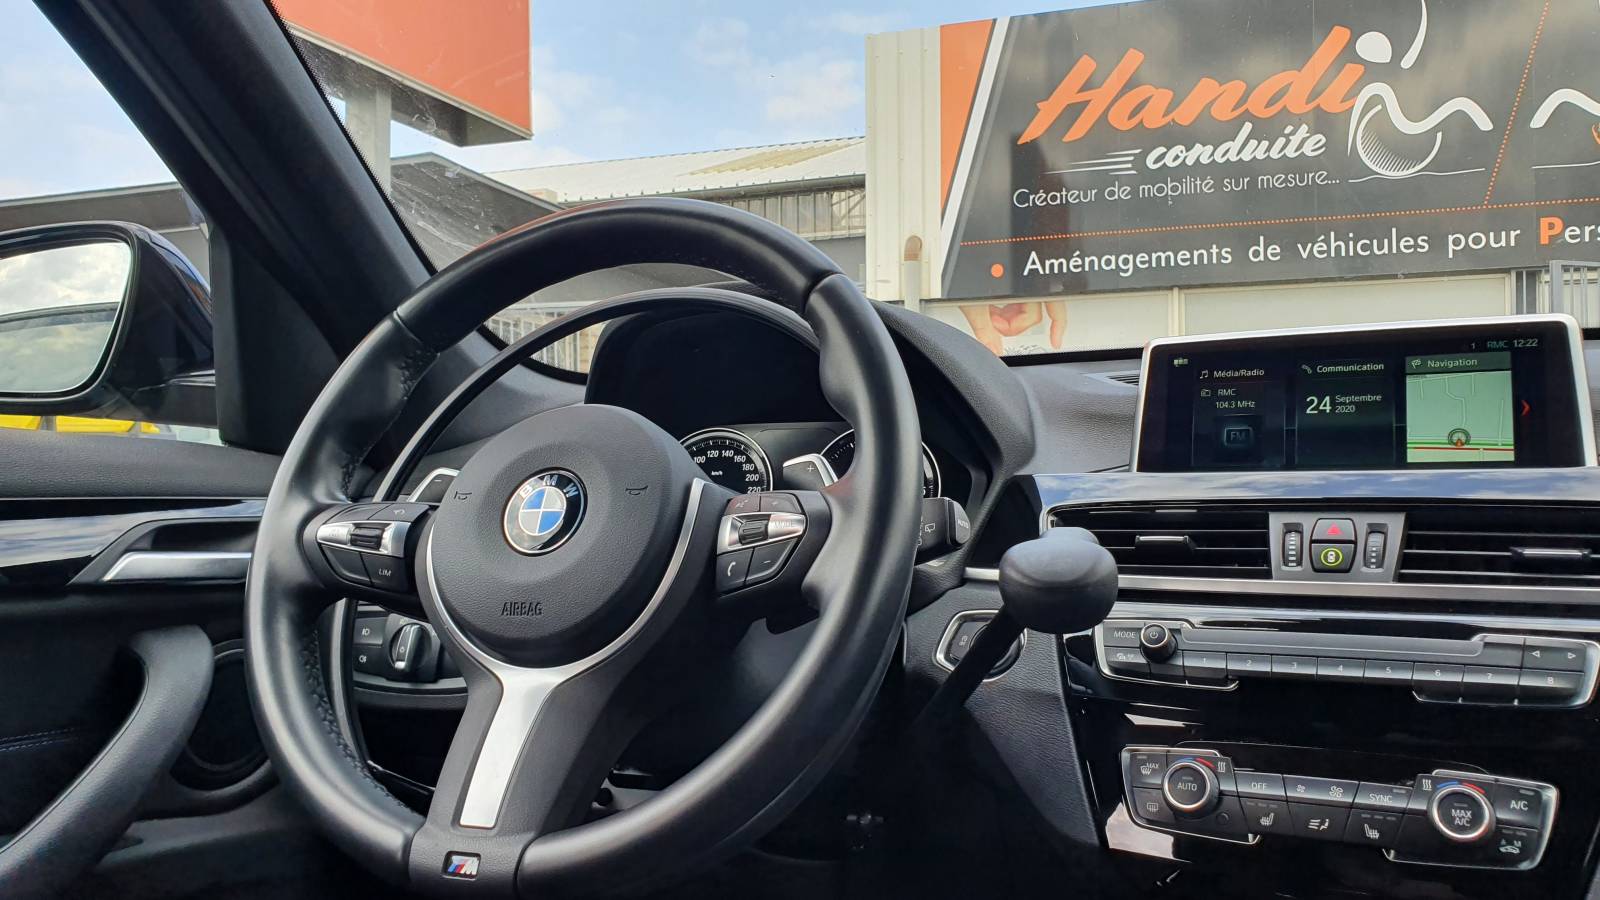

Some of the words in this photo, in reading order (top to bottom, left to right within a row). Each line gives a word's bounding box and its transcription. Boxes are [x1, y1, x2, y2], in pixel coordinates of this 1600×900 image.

[1016, 25, 1365, 145] Handi
[1146, 121, 1327, 170] conduite
[1013, 185, 1097, 208] Créateur
[1104, 177, 1132, 201] de
[1139, 174, 1215, 198] mobilité
[1223, 176, 1250, 193] sur
[1258, 169, 1340, 190] mesure...
[1023, 243, 1232, 277] Aménagements
[1248, 235, 1281, 263] de
[1297, 227, 1430, 259] véhicules
[1448, 229, 1521, 259] pour
[1487, 340, 1508, 349] RMC
[1512, 339, 1538, 348] 12:22
[1316, 363, 1384, 373] Communication
[1427, 358, 1478, 369] Navigation
[1213, 369, 1265, 378] Média/Radio
[1218, 388, 1237, 396] RMC
[1335, 393, 1382, 403] Septembre
[1215, 401, 1236, 409] 104.3
[1237, 400, 1256, 408] MHz
[1306, 395, 1332, 414] 24
[1335, 404, 1356, 413] 2020
[1230, 431, 1247, 441] FM
[707, 450, 719, 458] 120
[694, 456, 706, 464] 100
[734, 455, 746, 463] 160
[742, 463, 755, 471] 180
[745, 474, 759, 482] 200
[519, 474, 579, 499] BMW
[378, 568, 392, 577] LIM
[501, 601, 543, 617] AIRBAG
[1113, 630, 1136, 639] MODE
[1246, 659, 1252, 667] 2
[1336, 664, 1343, 672] 4
[1386, 666, 1392, 674] 5
[1435, 669, 1441, 677] 6
[1487, 672, 1493, 680] 7
[1547, 676, 1554, 684] 8
[1177, 782, 1198, 791] AUTO
[1251, 782, 1267, 791] OFF
[1369, 793, 1393, 803] SYNC
[1510, 800, 1529, 812] A/C
[1452, 808, 1472, 819] MAX
[1454, 816, 1471, 827] A/C
